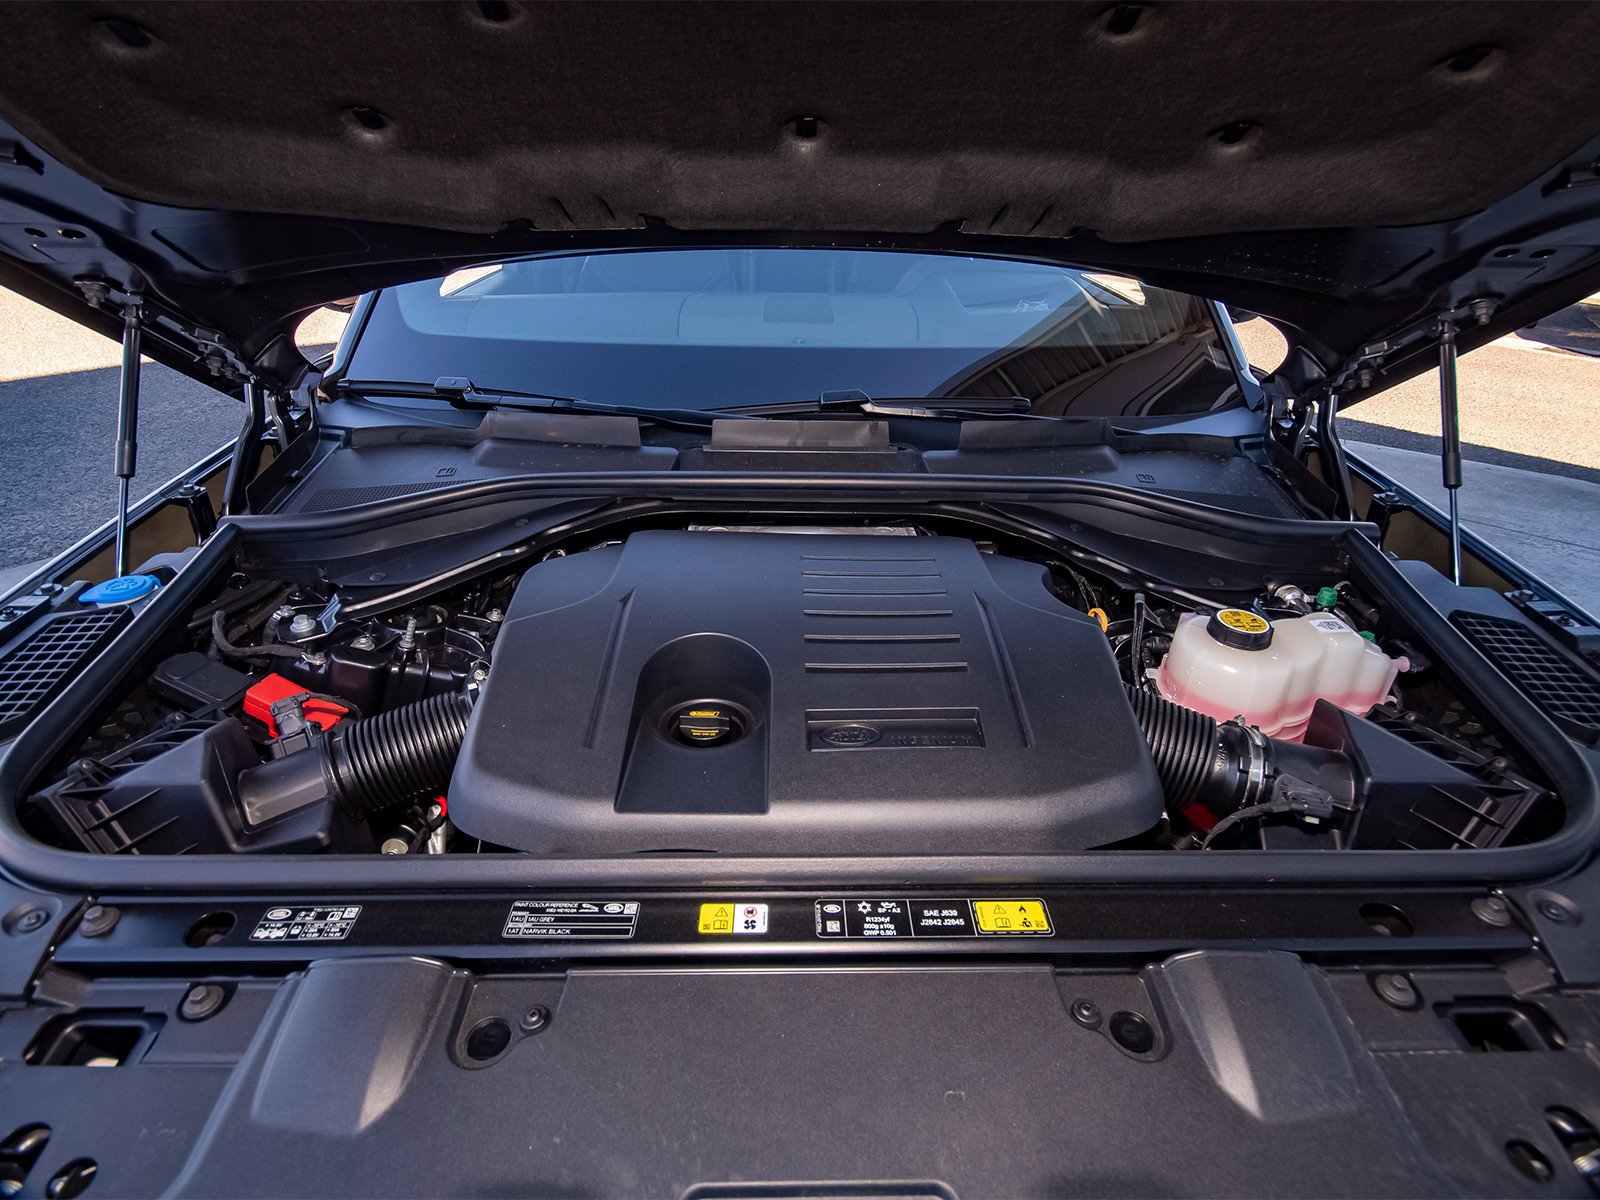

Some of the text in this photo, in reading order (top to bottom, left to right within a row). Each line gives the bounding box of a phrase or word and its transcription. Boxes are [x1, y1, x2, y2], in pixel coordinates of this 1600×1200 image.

[891, 735, 974, 744] INGENIUM
[923, 909, 958, 917] SAE J639
[920, 918, 965, 926] J2842 J2845
